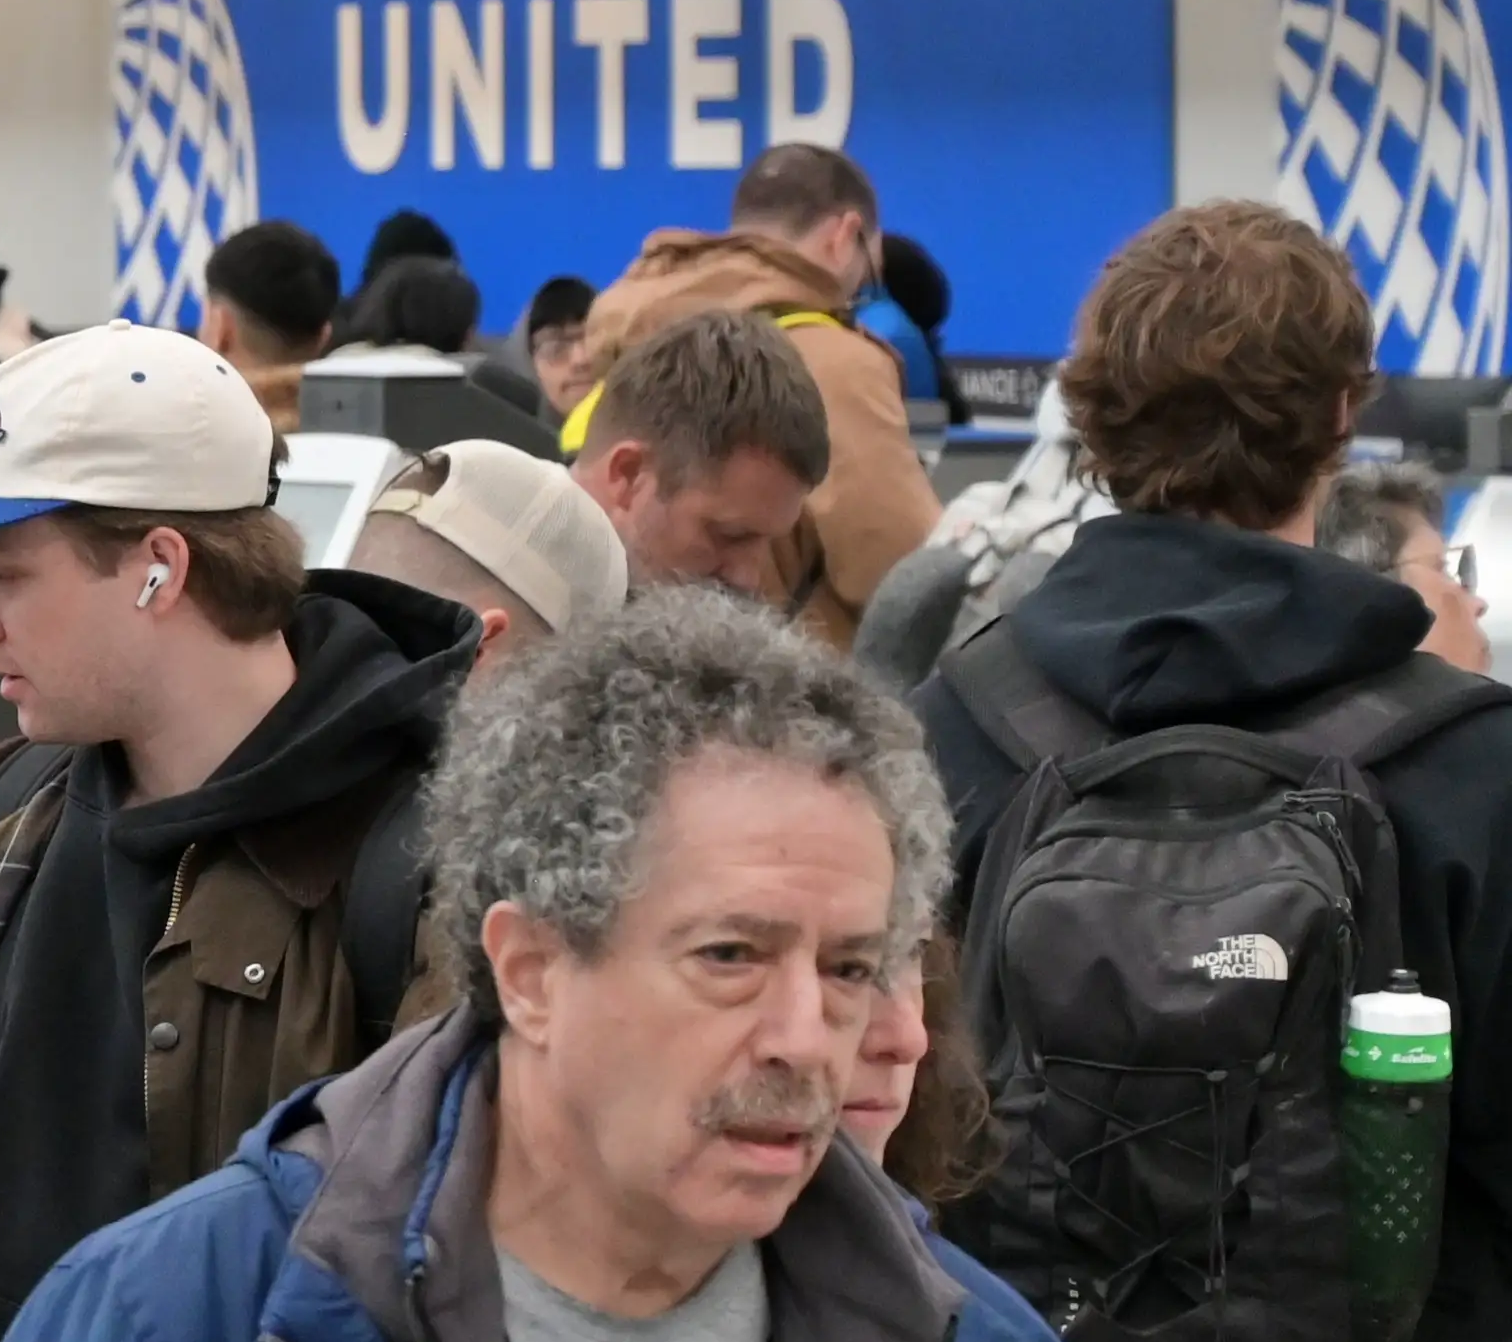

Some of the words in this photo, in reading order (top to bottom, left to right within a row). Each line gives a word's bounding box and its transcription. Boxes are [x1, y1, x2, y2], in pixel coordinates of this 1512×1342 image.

[1219, 935, 1254, 949] THE
[1192, 949, 1254, 968] NORTH
[1209, 963, 1256, 979] FACE
